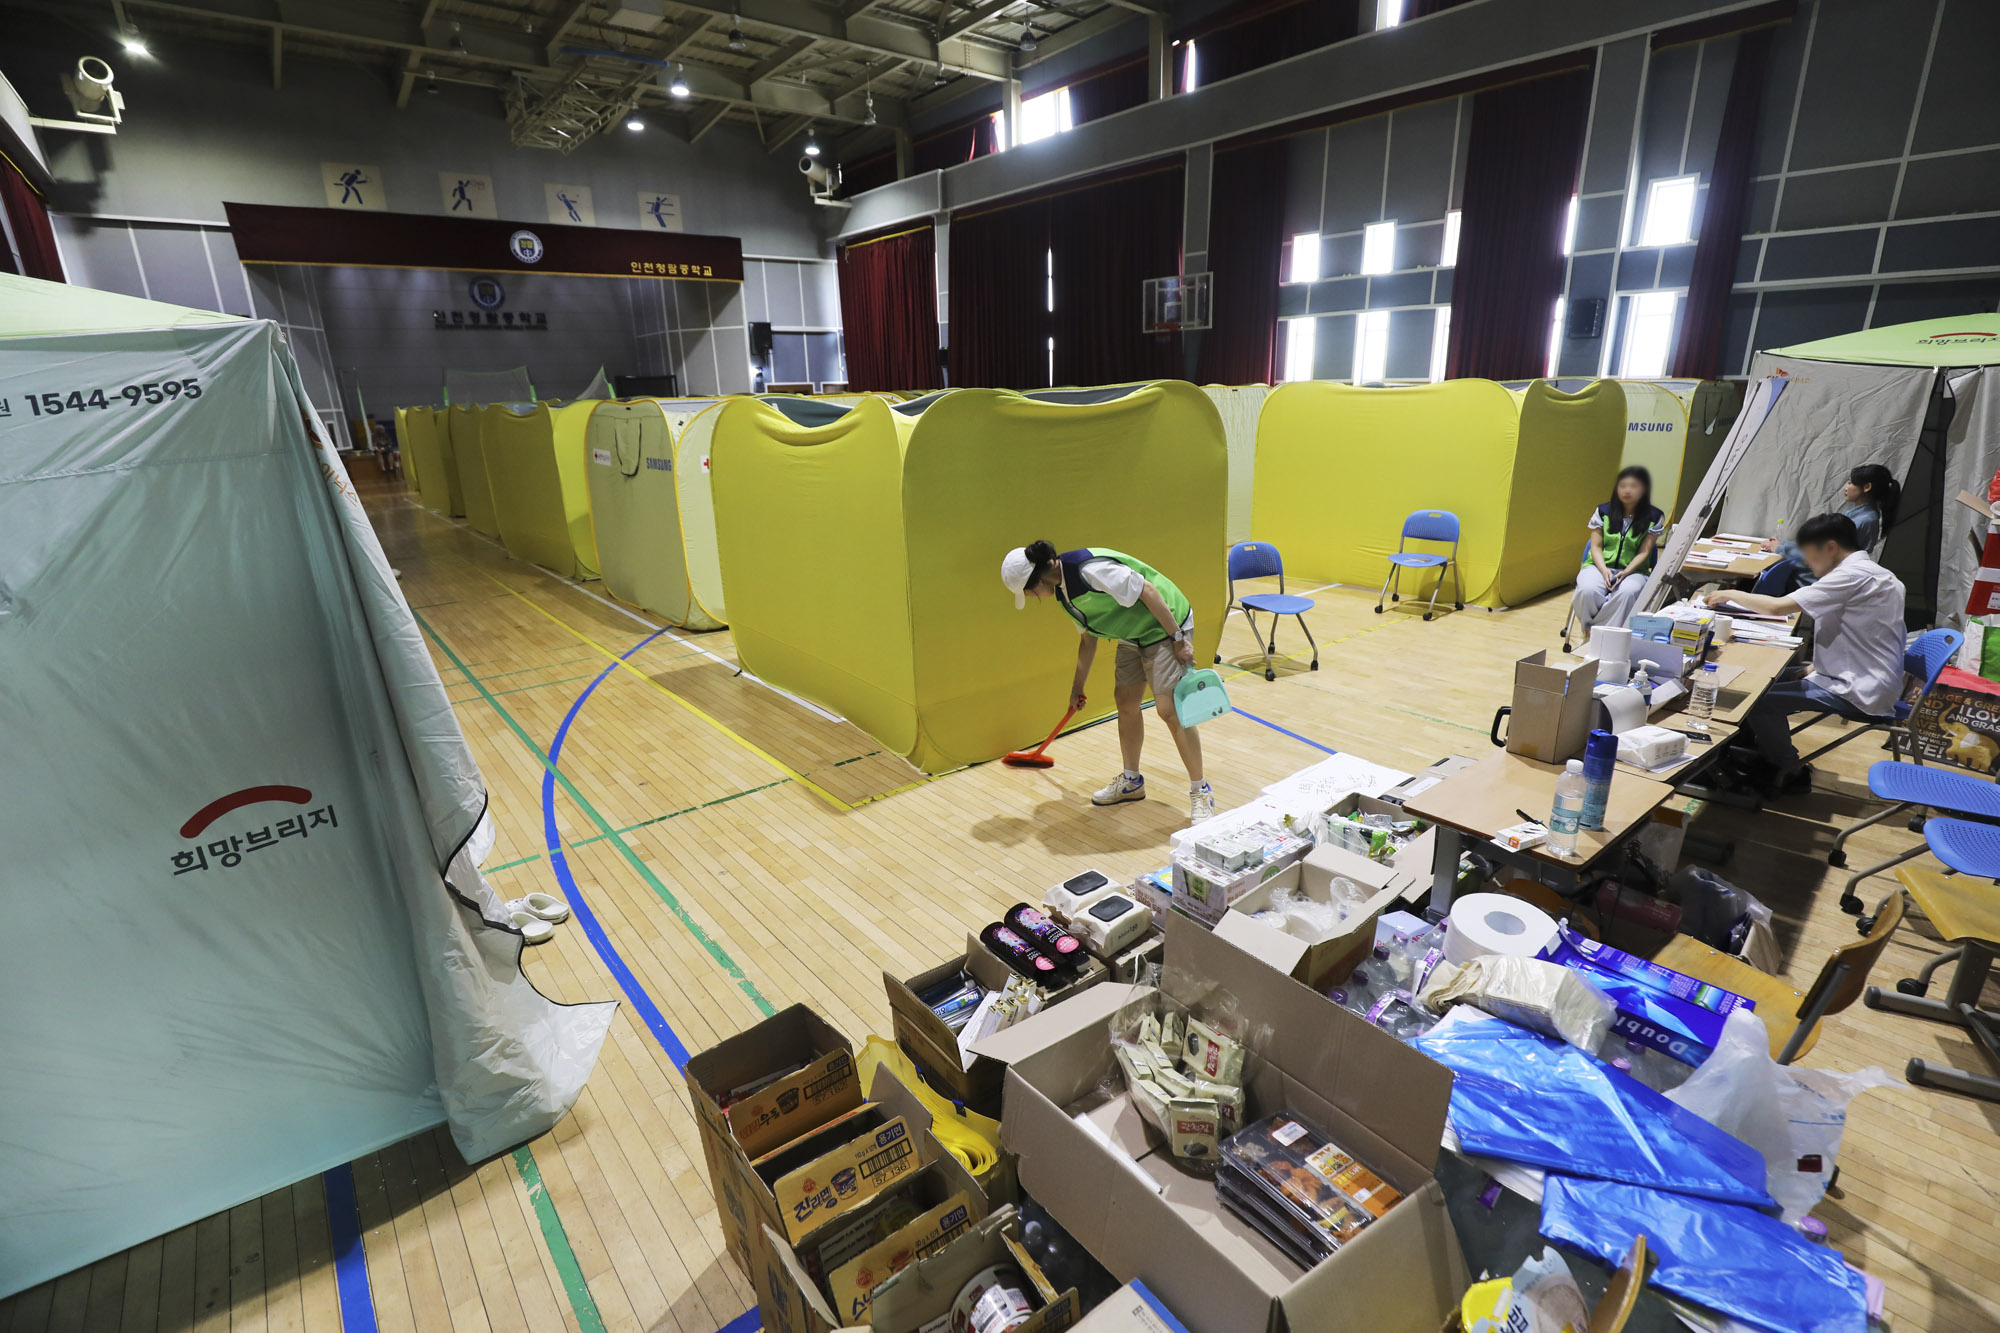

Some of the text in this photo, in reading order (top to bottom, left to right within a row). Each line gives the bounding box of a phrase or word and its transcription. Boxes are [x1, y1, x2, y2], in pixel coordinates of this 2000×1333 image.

[630, 261, 713, 277] 인천청람중학교
[25, 378, 202, 416] 1544-9595
[1628, 422, 1673, 433] MSUNG
[646, 457, 672, 471] SAMSUNG
[1920, 707, 1938, 717] EES
[1959, 705, 2000, 723] I LOV
[1974, 701, 2000, 712] GRE
[1947, 713, 2000, 732] AND GRAS
[1930, 738, 1947, 746] WILD
[1616, 1016, 1690, 1055] Doubl
[878, 1123, 904, 1144] 용기면
[875, 1164, 907, 1185] 57 136
[793, 1184, 833, 1223] 진라면
[943, 1206, 965, 1228] 용기면
